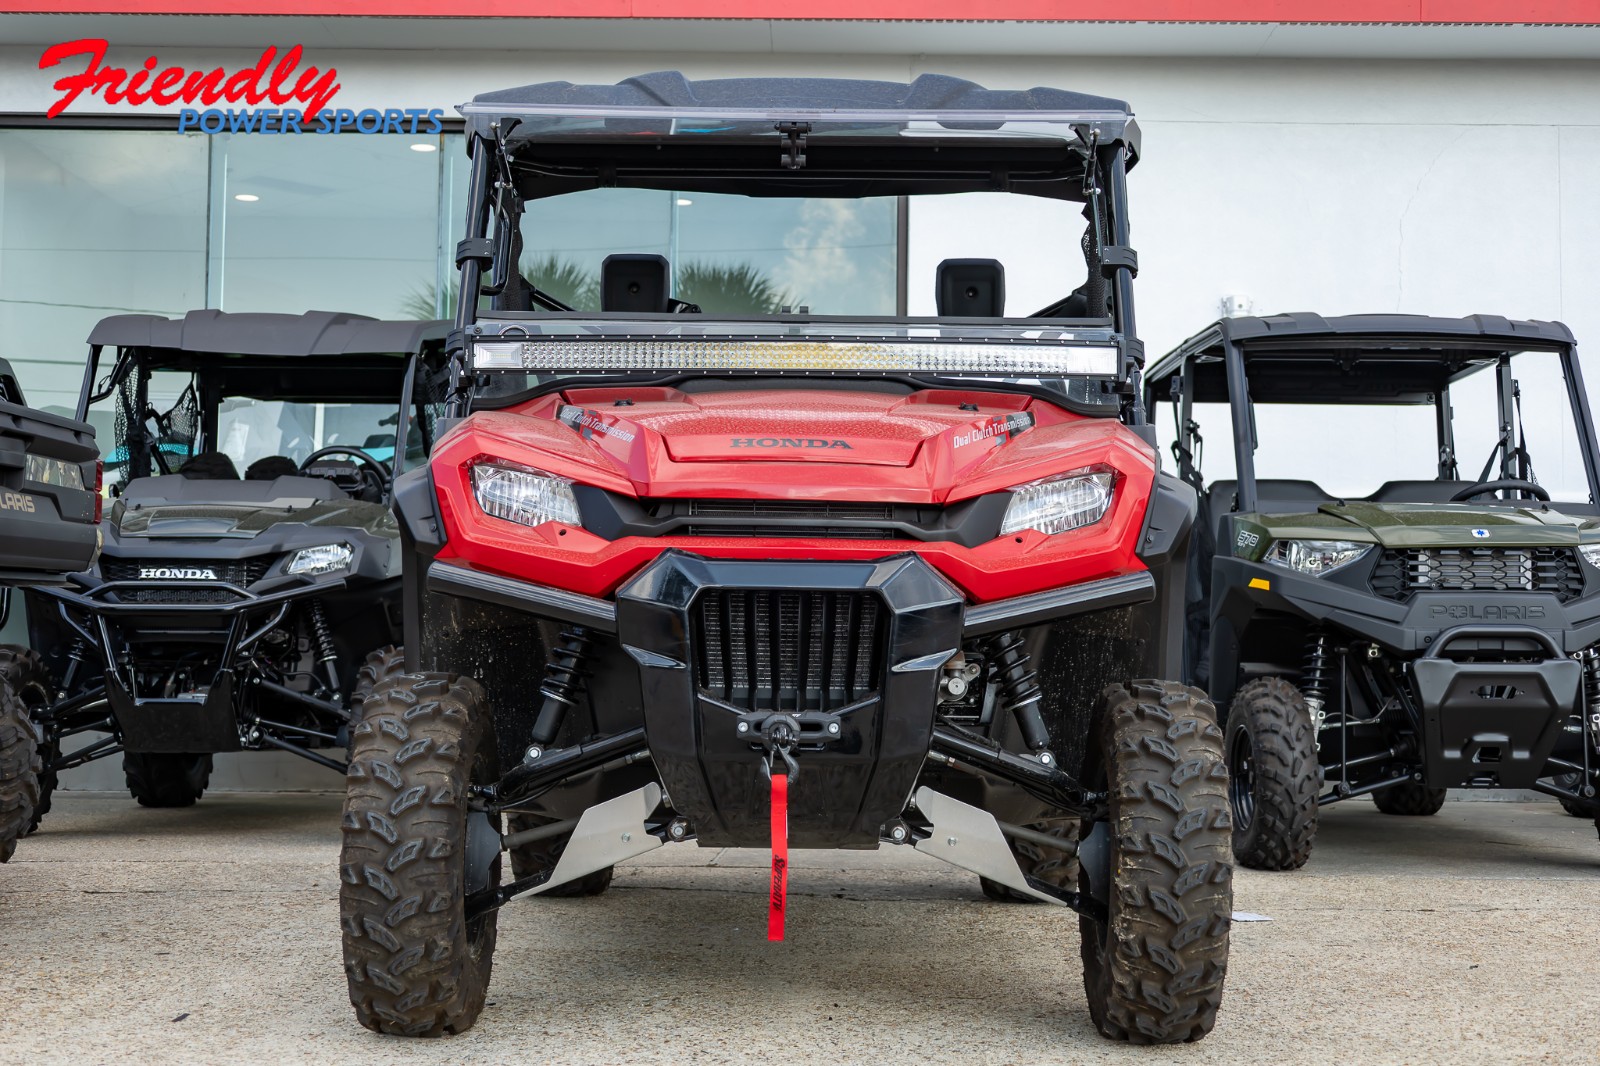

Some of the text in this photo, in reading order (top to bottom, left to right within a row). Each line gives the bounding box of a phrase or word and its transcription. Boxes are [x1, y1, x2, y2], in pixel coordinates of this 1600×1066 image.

[590, 417, 635, 443] Transmission
[953, 415, 1031, 448] Dual Clutch Transmission
[730, 438, 853, 449] HONDA
[1237, 530, 1259, 547] 570
[139, 568, 217, 580] HONDA
[1428, 604, 1546, 620] POLARIS
